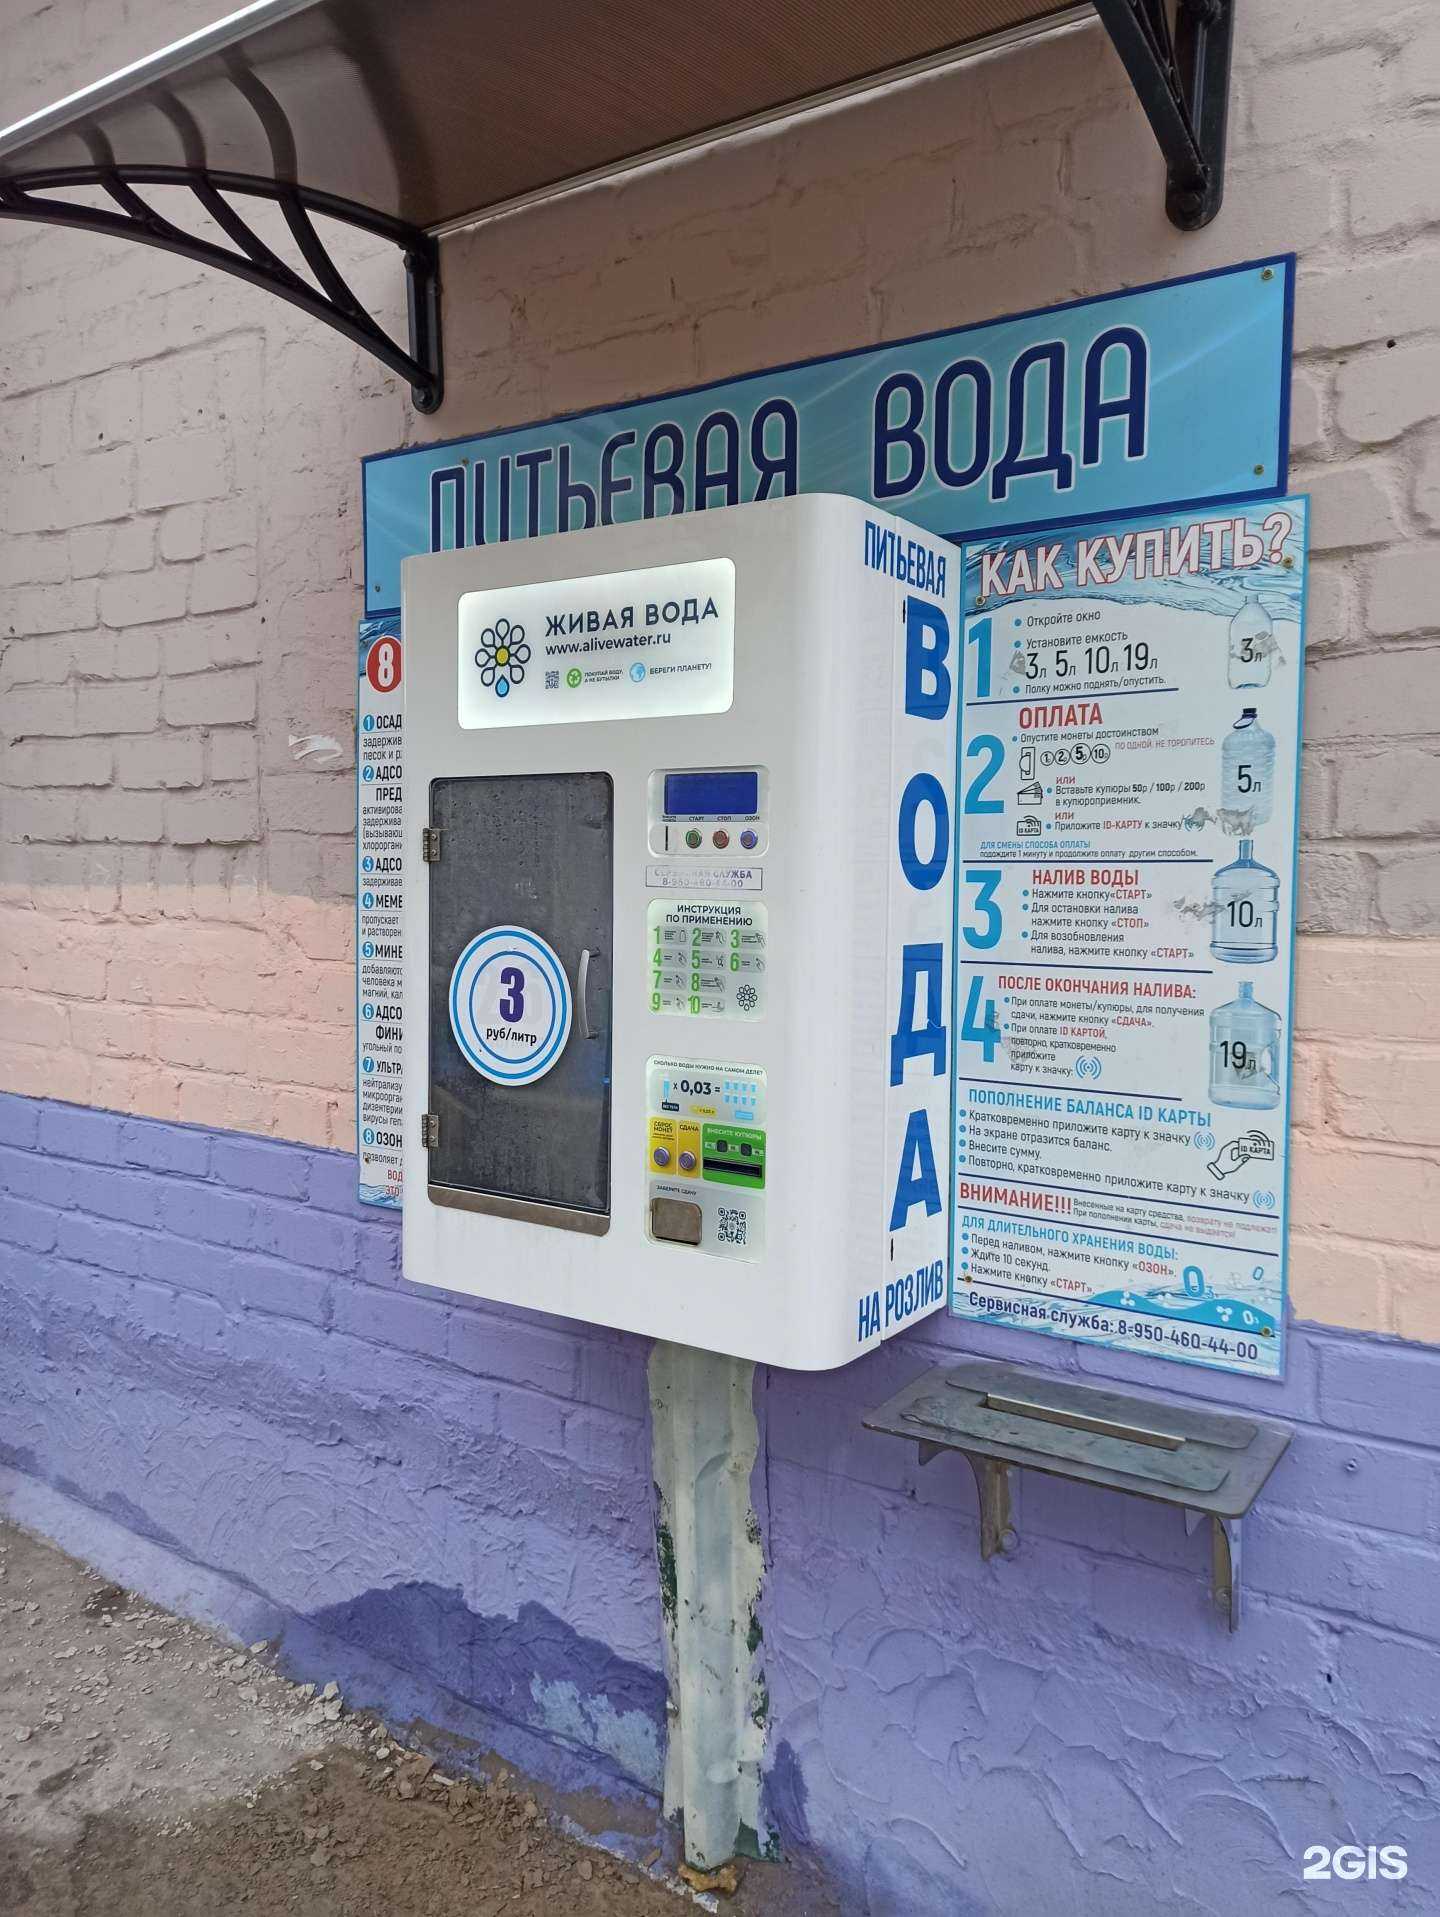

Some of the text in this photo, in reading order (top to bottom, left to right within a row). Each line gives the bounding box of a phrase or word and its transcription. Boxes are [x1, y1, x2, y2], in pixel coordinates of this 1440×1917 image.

[430, 326, 1150, 552] ПИТЬЕВАЯ ВОДА
[864, 520, 946, 598] ПИТЬЕВАЯ
[981, 512, 1292, 597] КАК КУПИТЬ?
[545, 597, 719, 637] ЖИВАЯ ВОДА
[1027, 610, 1101, 628] Откройте окно
[545, 634, 671, 656] www.alivewater.ru
[1026, 631, 1128, 650] Установите емкость
[378, 643, 394, 687] 8
[968, 617, 993, 698] 1
[650, 663, 712, 674] БЕРЕГИ ПЛАНЕТУ!
[1025, 675, 1167, 695] Полку можно поднять/опустить.
[1019, 703, 1103, 729] ОПЛАТА
[1021, 727, 1159, 744] Опустите монеты достоинством
[363, 750, 386, 761] песок
[964, 734, 1005, 814] 2
[1056, 784, 1131, 795] Вставьте купюры
[1055, 820, 1143, 831] Приложите ID-КАРТУ
[980, 840, 1090, 850] ДЛЯ СМЕНЫ СПОСОБА ОПЛАТЫ
[1033, 869, 1139, 887] НАЛИВ ВОДЫ
[1032, 889, 1074, 899] Нажмите
[677, 905, 741, 916] ИНСТРУКЦИЯ
[889, 595, 951, 1231] ВОДА
[963, 870, 1002, 949] 3
[1031, 903, 1139, 915] Для остановки налива
[362, 915, 399, 926] пропускает
[666, 915, 753, 925] ПО ПРИМЕНЕНИЮ
[1031, 918, 1109, 929] нажмите кнопку
[653, 926, 660, 944] 1
[692, 928, 701, 946] 2
[730, 929, 740, 948] 3
[1030, 931, 1124, 942] Для возобновления
[653, 948, 740, 971] 4 5 6
[1068, 947, 1148, 959] нажмите кнопку
[362, 976, 395, 987] человека
[653, 970, 662, 988] 7
[691, 973, 700, 991] 8
[998, 976, 1197, 999] ПОСЛЕ ОКОНЧАНИЯ НАЛИВА:
[500, 967, 525, 1023] 3
[652, 993, 700, 1014] 9 10
[1011, 997, 1205, 1017] При оплате для получения
[961, 976, 1001, 1063] 4
[1039, 1013, 1109, 1025] нажмите кнопку
[486, 1028, 537, 1046] руб/литр
[1011, 1023, 1058, 1035] При оплате
[362, 1042, 393, 1053] угольный
[1050, 1040, 1117, 1053] кратковременно
[1010, 1062, 1033, 1074] карту
[680, 1079, 712, 1096] 0,03
[969, 1088, 1212, 1127] ПОПОЛНЕНИЕ БАЛАНСА КАРТЫ
[362, 1114, 395, 1126] вирусы
[680, 1124, 698, 1132] СДАЧА
[969, 1110, 1191, 1146] Кратковременно приложите значку
[984, 1128, 1070, 1146] экране отразится
[969, 1140, 1007, 1155] Внесите
[1018, 1164, 1250, 1204] кратковременно приложите карту значку
[960, 1182, 1072, 1214] ВНИМАНИЕ!!!
[962, 1215, 1135, 1254] ДЛЯ ДЛИТЕЛЬНОГО ХРАНЕНИЯ
[971, 1233, 1091, 1263] Перед нажмите
[971, 1248, 1000, 1263] Ждите
[971, 1263, 1048, 1287] Нажмите кнопку
[857, 1260, 944, 1343] НА РОЗЛИВ
[969, 1291, 1258, 1360] Сервисная служба: 8-950-460-44-00
